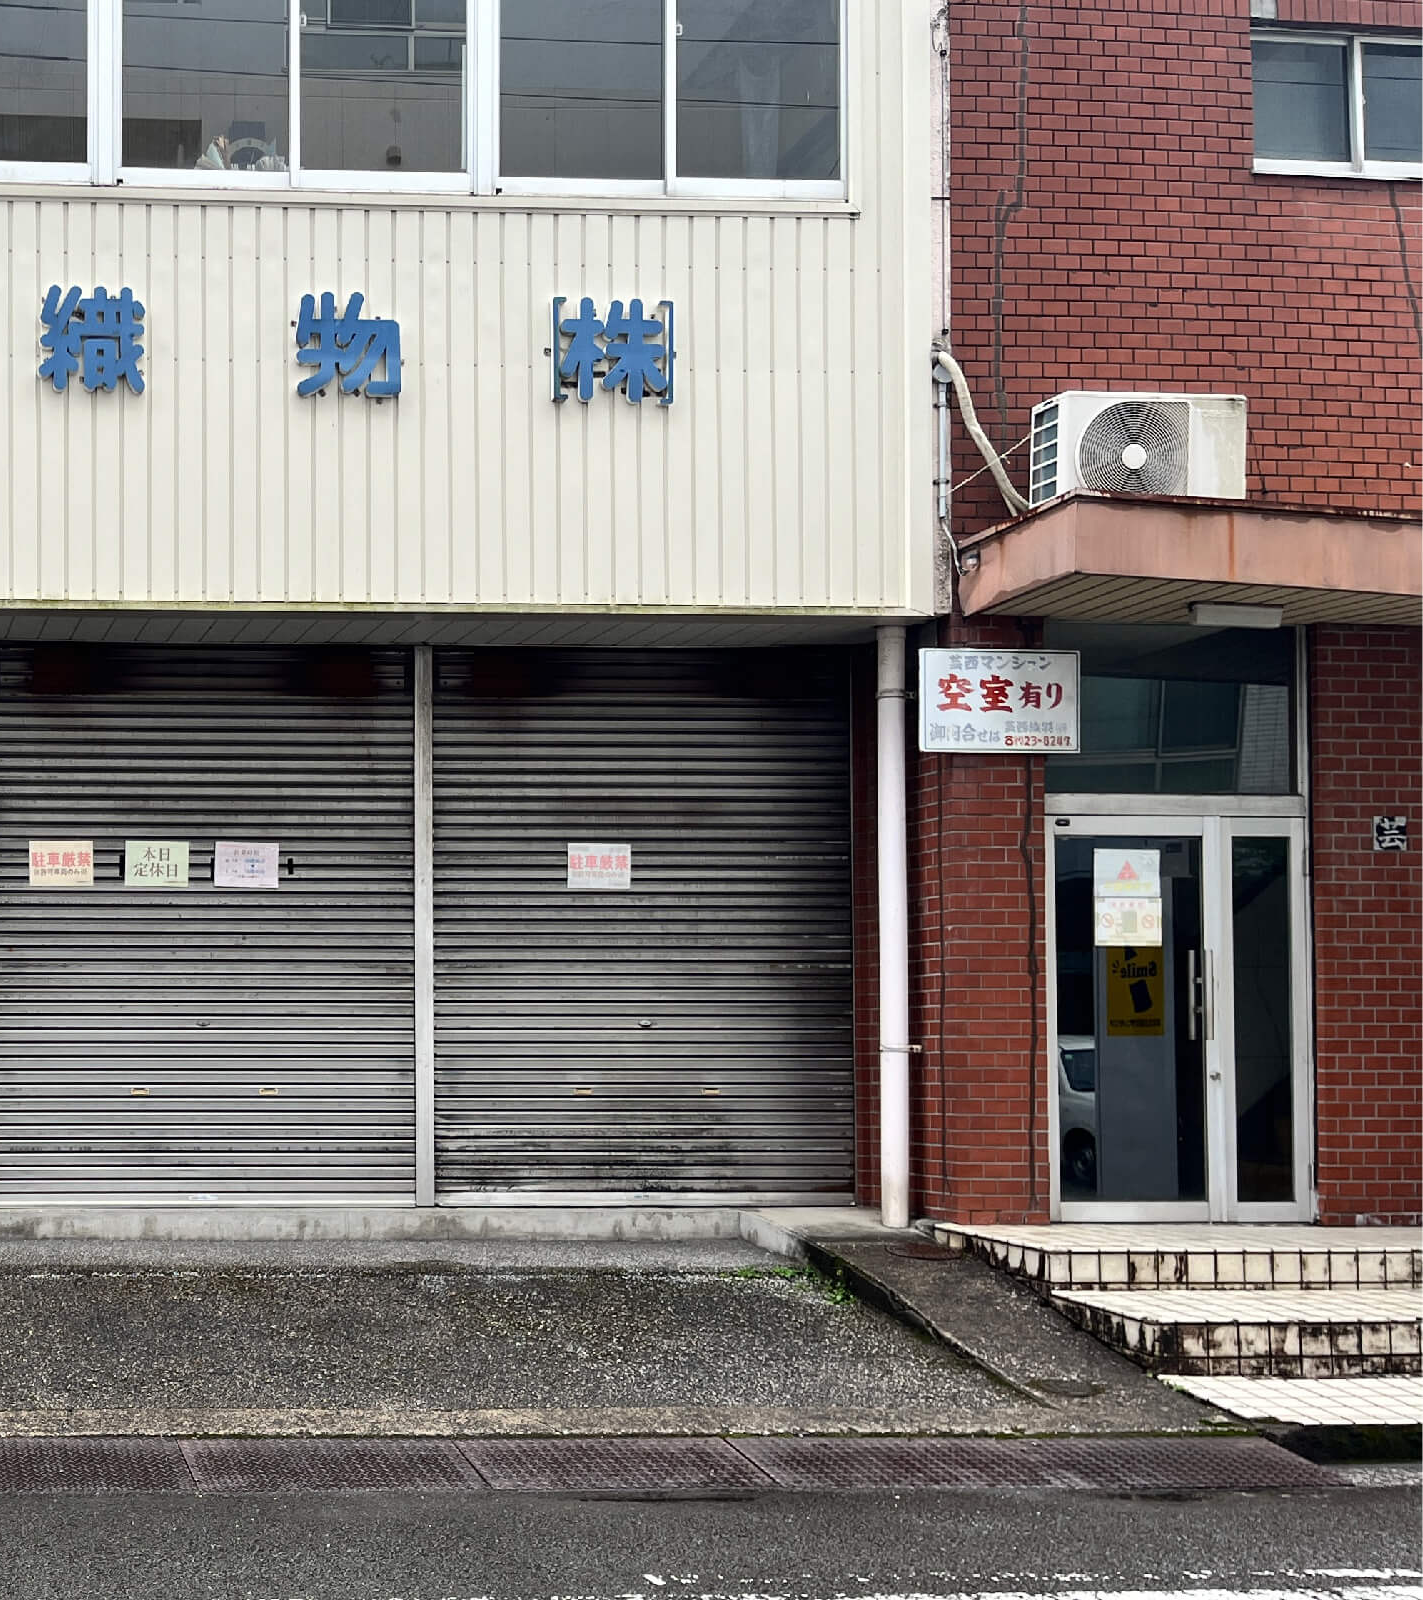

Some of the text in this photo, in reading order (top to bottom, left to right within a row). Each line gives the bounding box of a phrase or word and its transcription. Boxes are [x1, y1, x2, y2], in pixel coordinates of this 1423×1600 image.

[936, 673, 1063, 713] 空室有り
[31, 851, 92, 867] 駐車厳禁
[143, 847, 171, 863] 本日
[133, 863, 179, 878] 定休日
